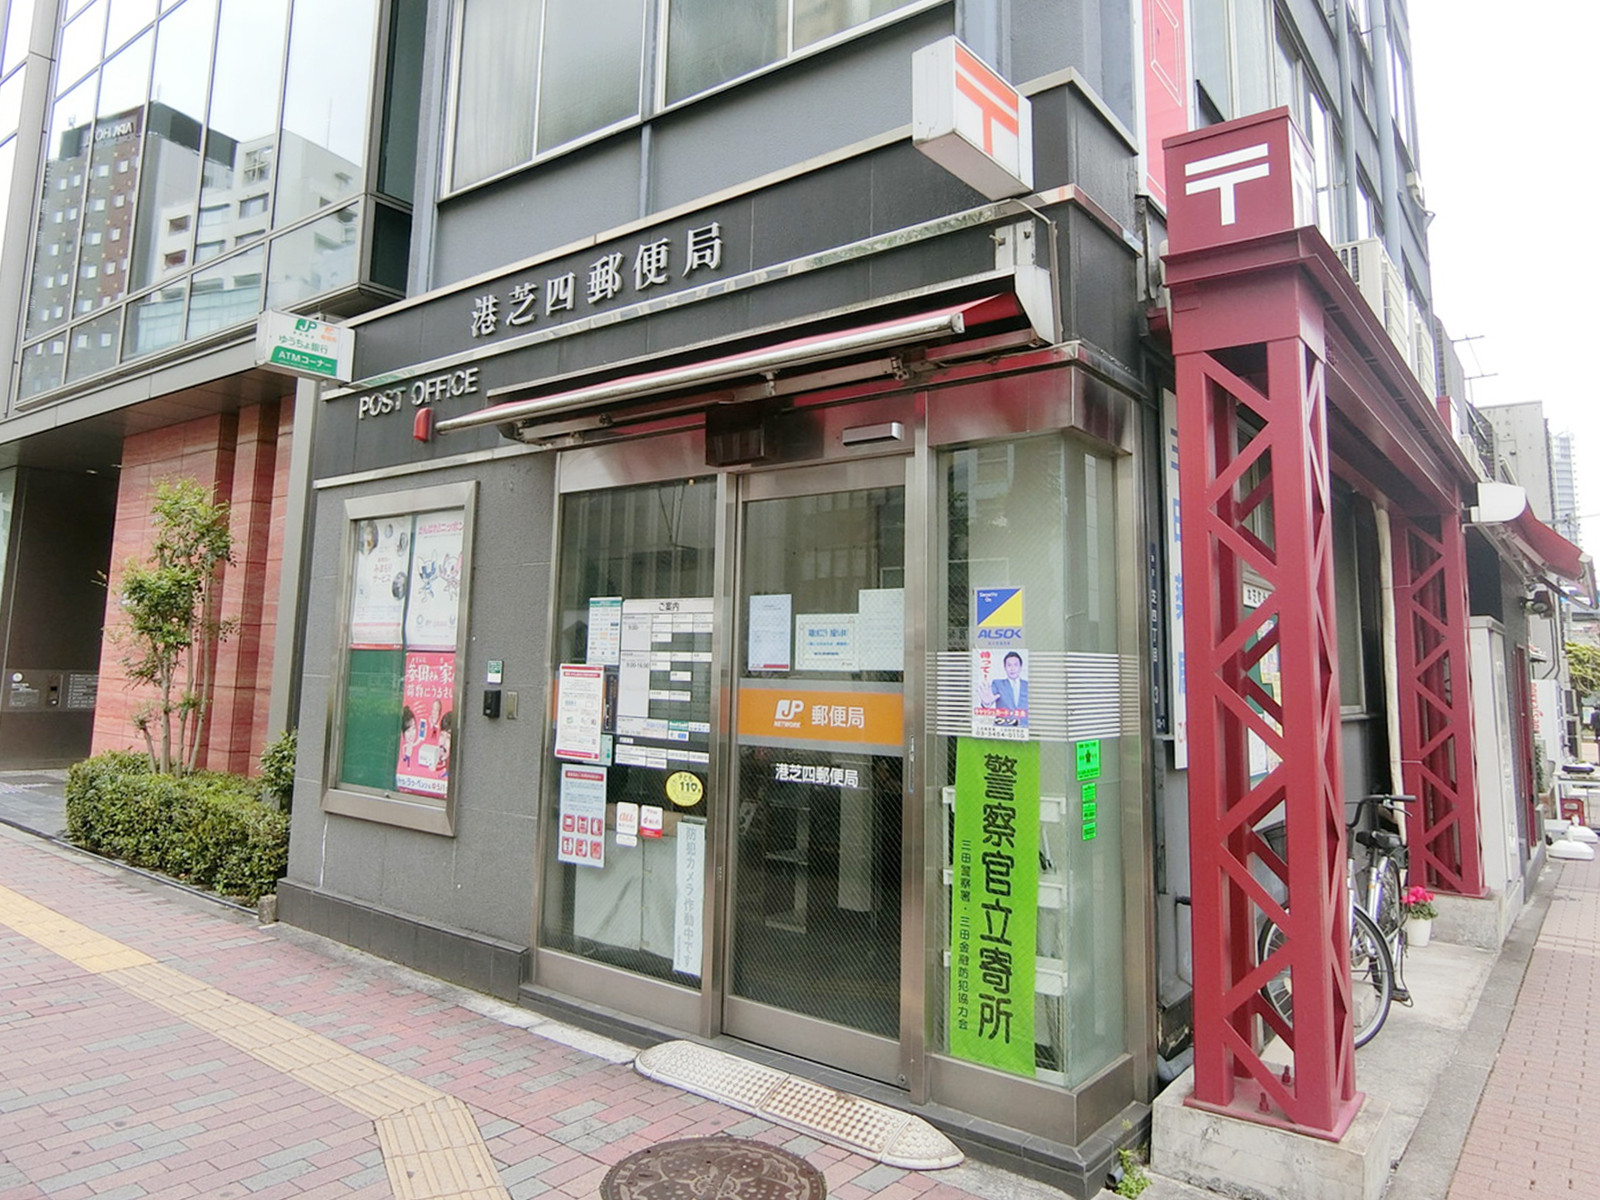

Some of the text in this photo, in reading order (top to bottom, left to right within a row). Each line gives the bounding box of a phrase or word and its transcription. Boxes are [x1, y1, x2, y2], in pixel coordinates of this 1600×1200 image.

[470, 221, 724, 338] 港芝四郵便局
[295, 318, 317, 332] JP
[279, 335, 328, 354] ゆうちょ銀行
[278, 351, 332, 367] ATMコーナー
[358, 367, 479, 420] POST OFFICE
[658, 601, 680, 611] ご案内
[977, 628, 1022, 639] ALSOK
[774, 699, 804, 720] JP
[811, 704, 864, 729] 郵便局
[773, 720, 801, 729] NETWORK
[774, 762, 859, 788] 港芝四郵便局
[683, 826, 697, 967] 防犯カメラ作動中です
[978, 752, 1018, 1044] 警察官立寄所
